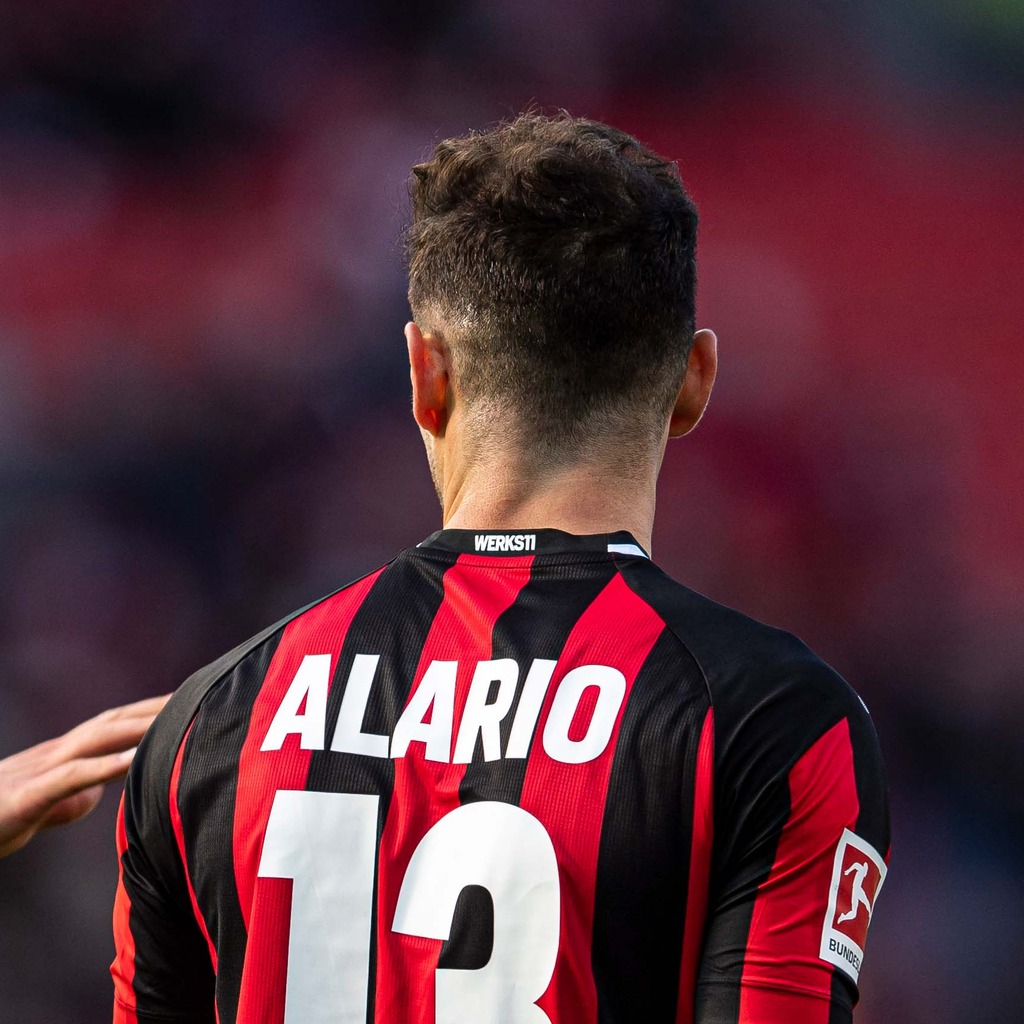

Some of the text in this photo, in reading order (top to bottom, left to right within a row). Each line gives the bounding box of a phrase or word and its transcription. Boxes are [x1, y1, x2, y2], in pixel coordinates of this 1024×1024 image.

[475, 534, 536, 551] WERKS11
[260, 653, 626, 764] ALARIO
[829, 937, 860, 973] BUNDES
